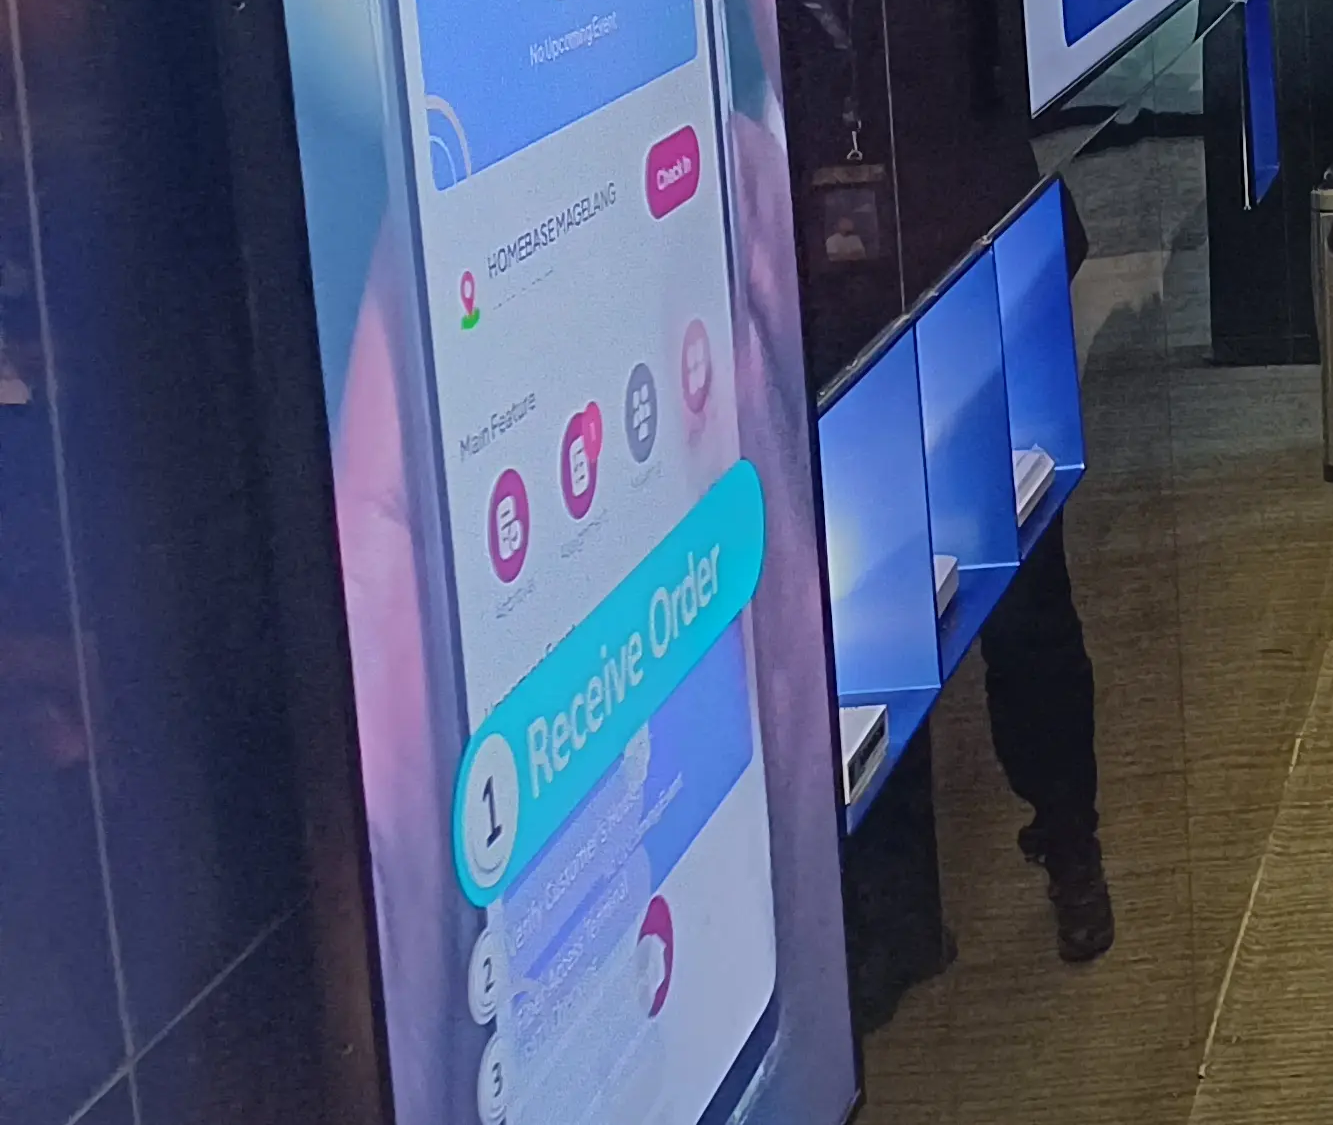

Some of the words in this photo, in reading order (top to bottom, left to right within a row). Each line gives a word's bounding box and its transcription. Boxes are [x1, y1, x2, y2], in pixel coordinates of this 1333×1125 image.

[487, 217, 556, 279] HOMEBASE
[555, 182, 616, 237] MAGELANG
[482, 775, 502, 849] 1
[527, 632, 644, 800] Receive
[649, 542, 720, 659] Order
